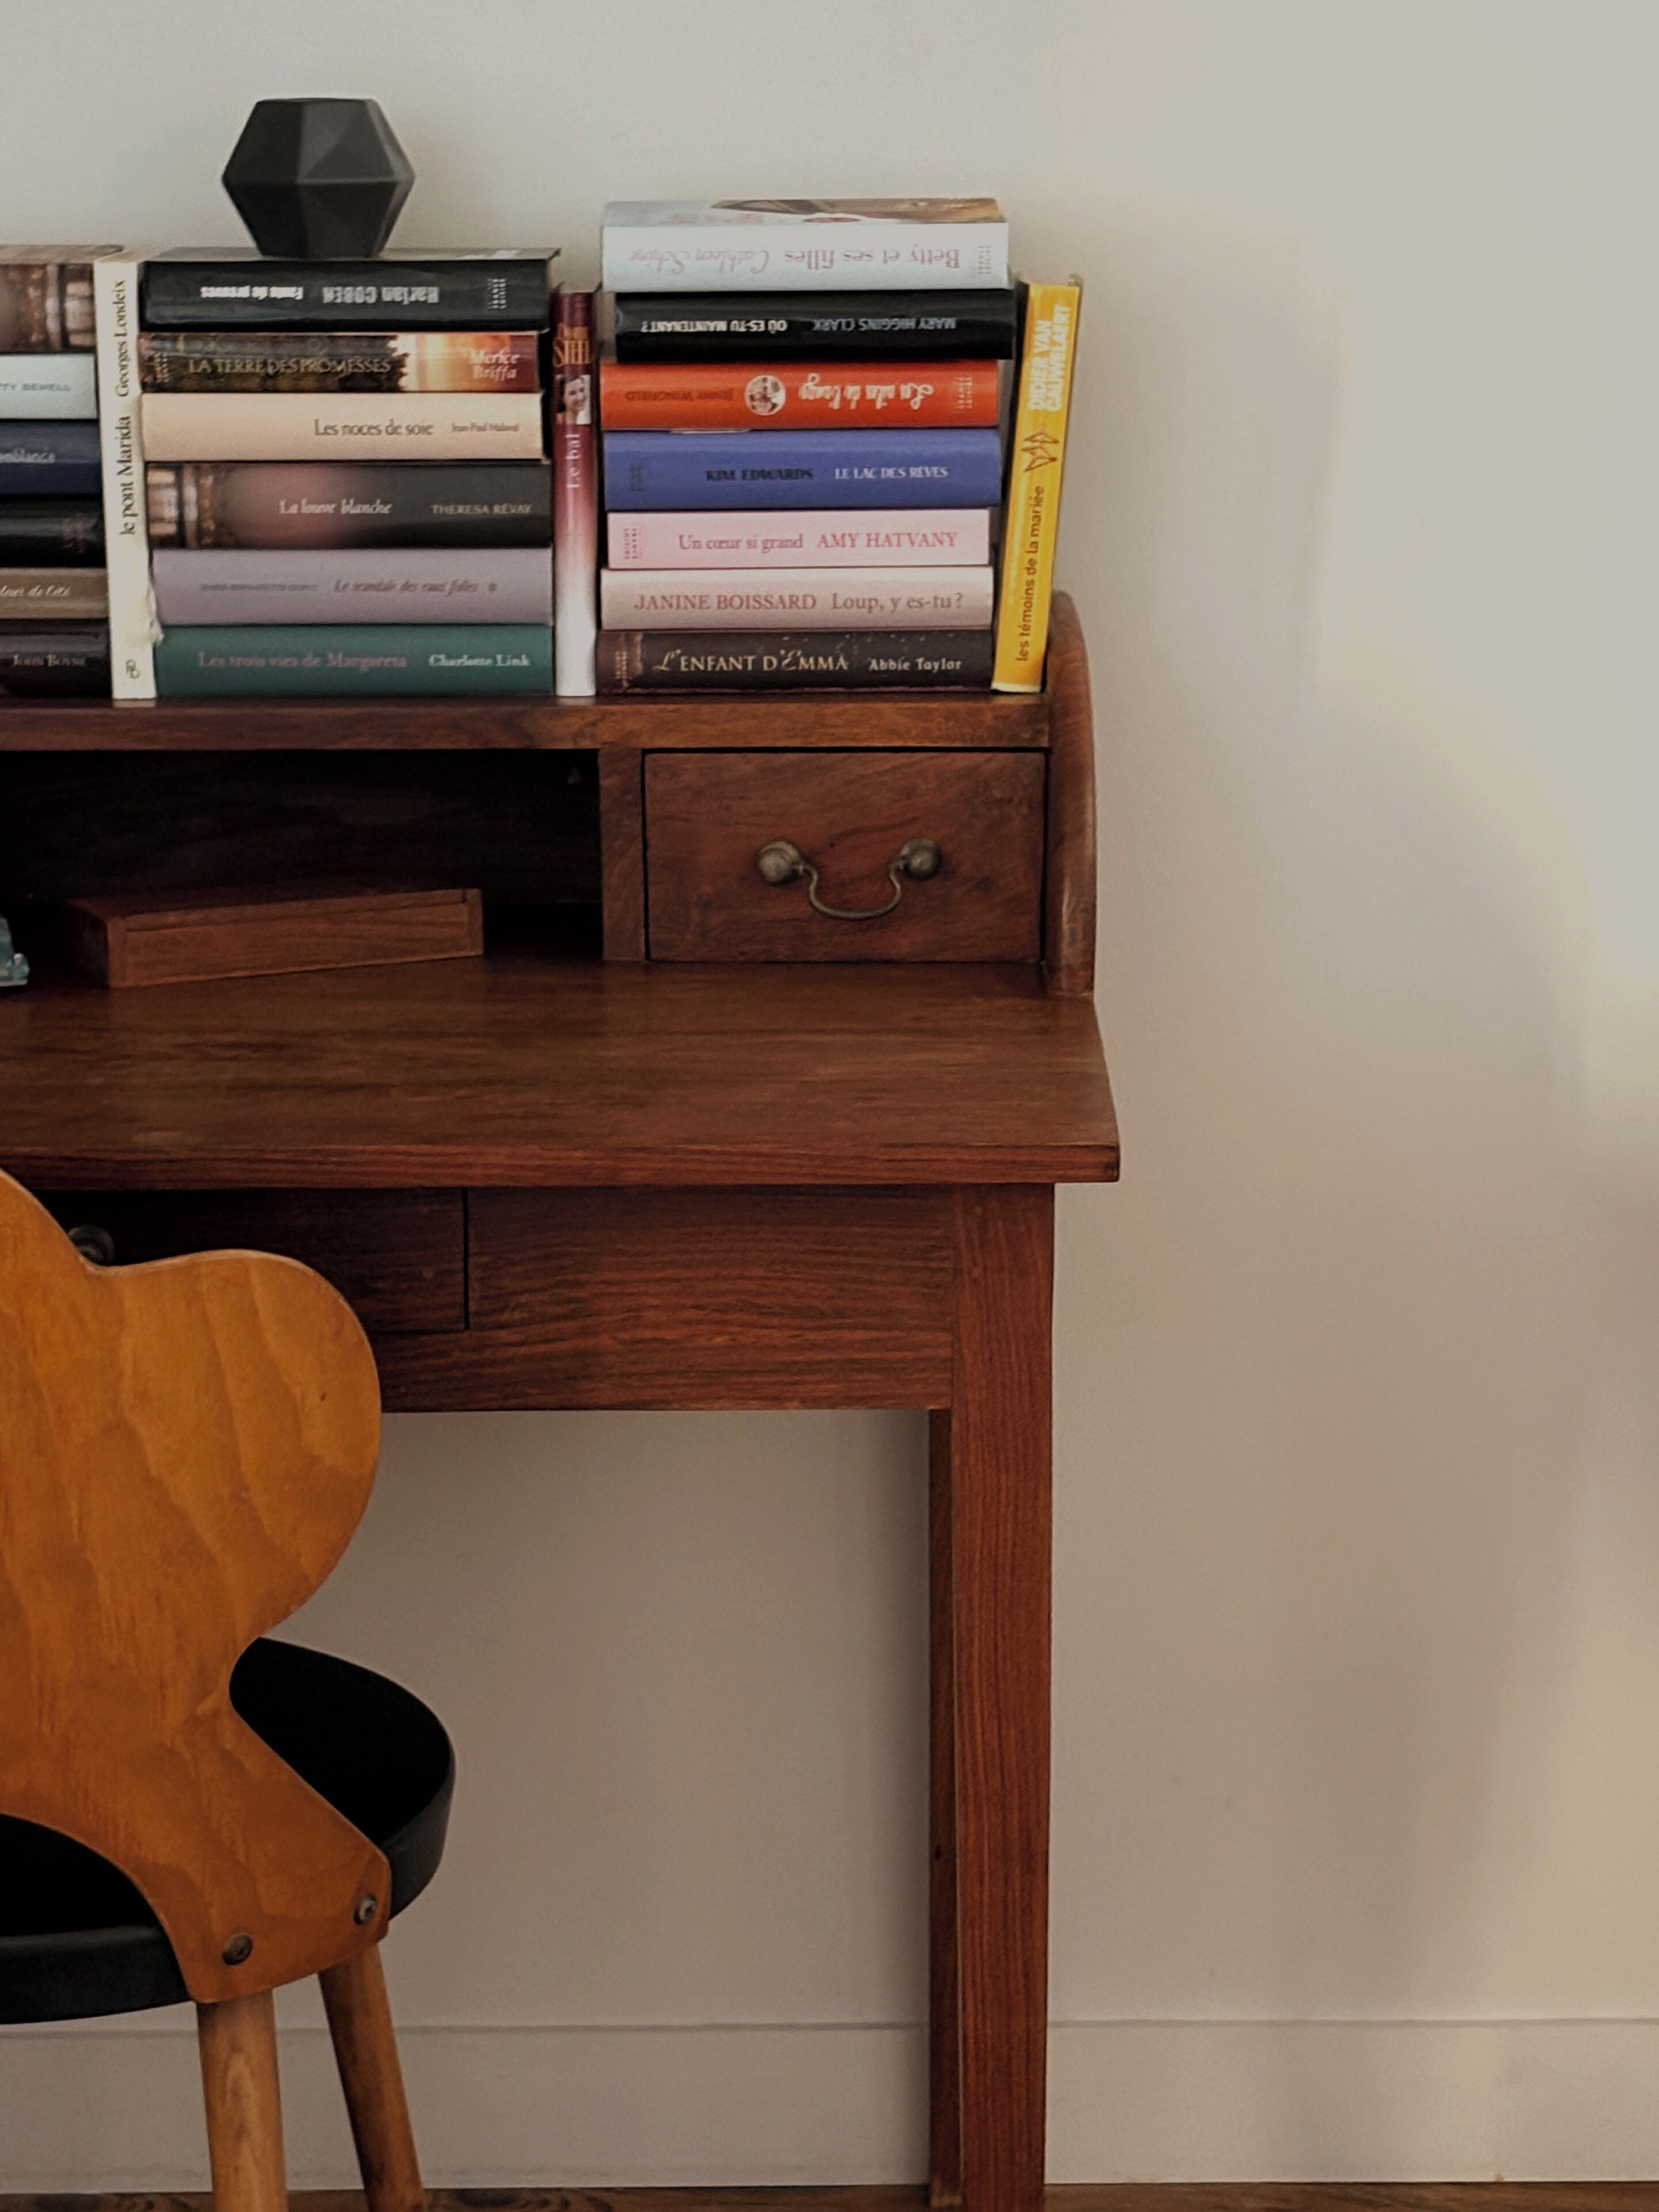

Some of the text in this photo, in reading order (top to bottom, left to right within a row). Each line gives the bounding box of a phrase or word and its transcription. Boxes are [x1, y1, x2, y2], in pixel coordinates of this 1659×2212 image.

[784, 249, 835, 270] filles
[843, 249, 874, 262] ses
[882, 249, 900, 265] et
[907, 244, 960, 268] Betty
[729, 319, 766, 332] ES-TU
[812, 317, 957, 331] MARY HIGGINS CLARK
[188, 359, 211, 373] LA
[217, 359, 264, 373] TERRE
[265, 358, 299, 375] DES
[300, 358, 392, 376] PROMESSES
[1028, 319, 1052, 410] DIDIER VAN
[1046, 304, 1071, 412] CAUWELAERT
[115, 340, 131, 397] Georges
[313, 418, 435, 437] Les noces de soie
[565, 433, 581, 460] bal
[115, 415, 139, 536] le pont Marida
[706, 467, 814, 482] KIM EDWARDS
[834, 467, 852, 480] LE
[854, 467, 878, 480] LAC
[880, 467, 907, 479] DES
[279, 499, 299, 514] La
[340, 498, 393, 515] blanche
[430, 504, 491, 514] THERESA
[679, 534, 703, 550] Un
[745, 535, 757, 549] si
[761, 533, 804, 553] grand
[817, 531, 959, 548] AMY HATVANY
[1015, 485, 1044, 661] les témoins de la mariée
[634, 593, 817, 611] JANINE BOISSARD
[830, 592, 884, 612] Loup,
[889, 597, 903, 613] y
[199, 650, 225, 667] Les
[229, 652, 265, 667] trois
[302, 651, 321, 667] de
[325, 651, 407, 672] Margareta
[427, 652, 530, 668] Charlotte Link
[653, 649, 757, 671] L'ENFANT
[868, 656, 962, 673] Abbie Taylor
